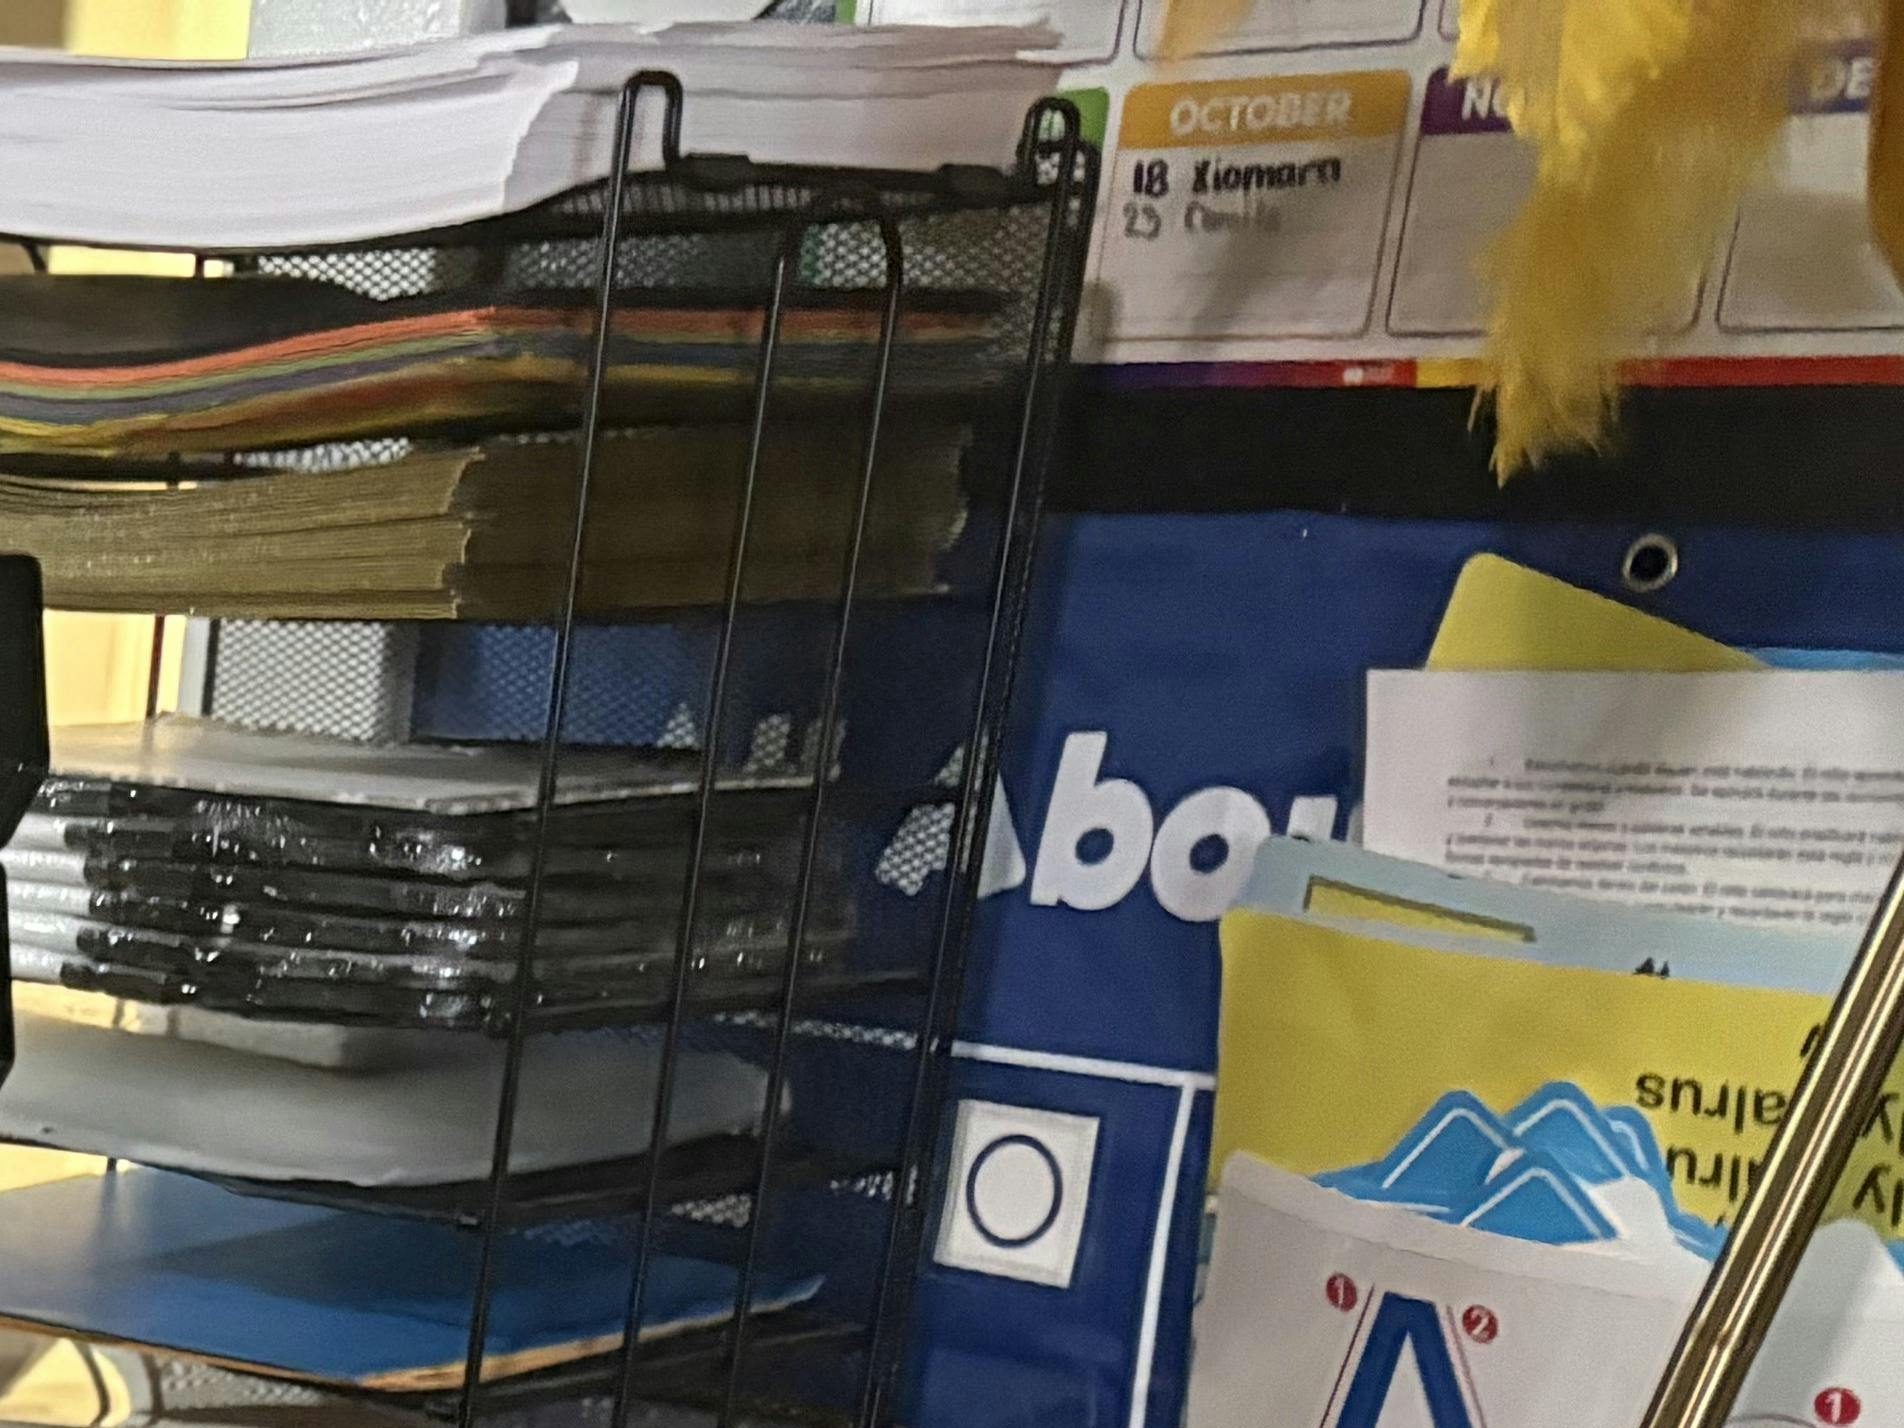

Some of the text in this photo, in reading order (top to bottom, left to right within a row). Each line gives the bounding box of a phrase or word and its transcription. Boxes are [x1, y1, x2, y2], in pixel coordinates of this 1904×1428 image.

[1169, 87, 1352, 138] OCTOBER
[1132, 158, 1169, 197] 18
[1634, 1071, 1789, 1136] alrus
